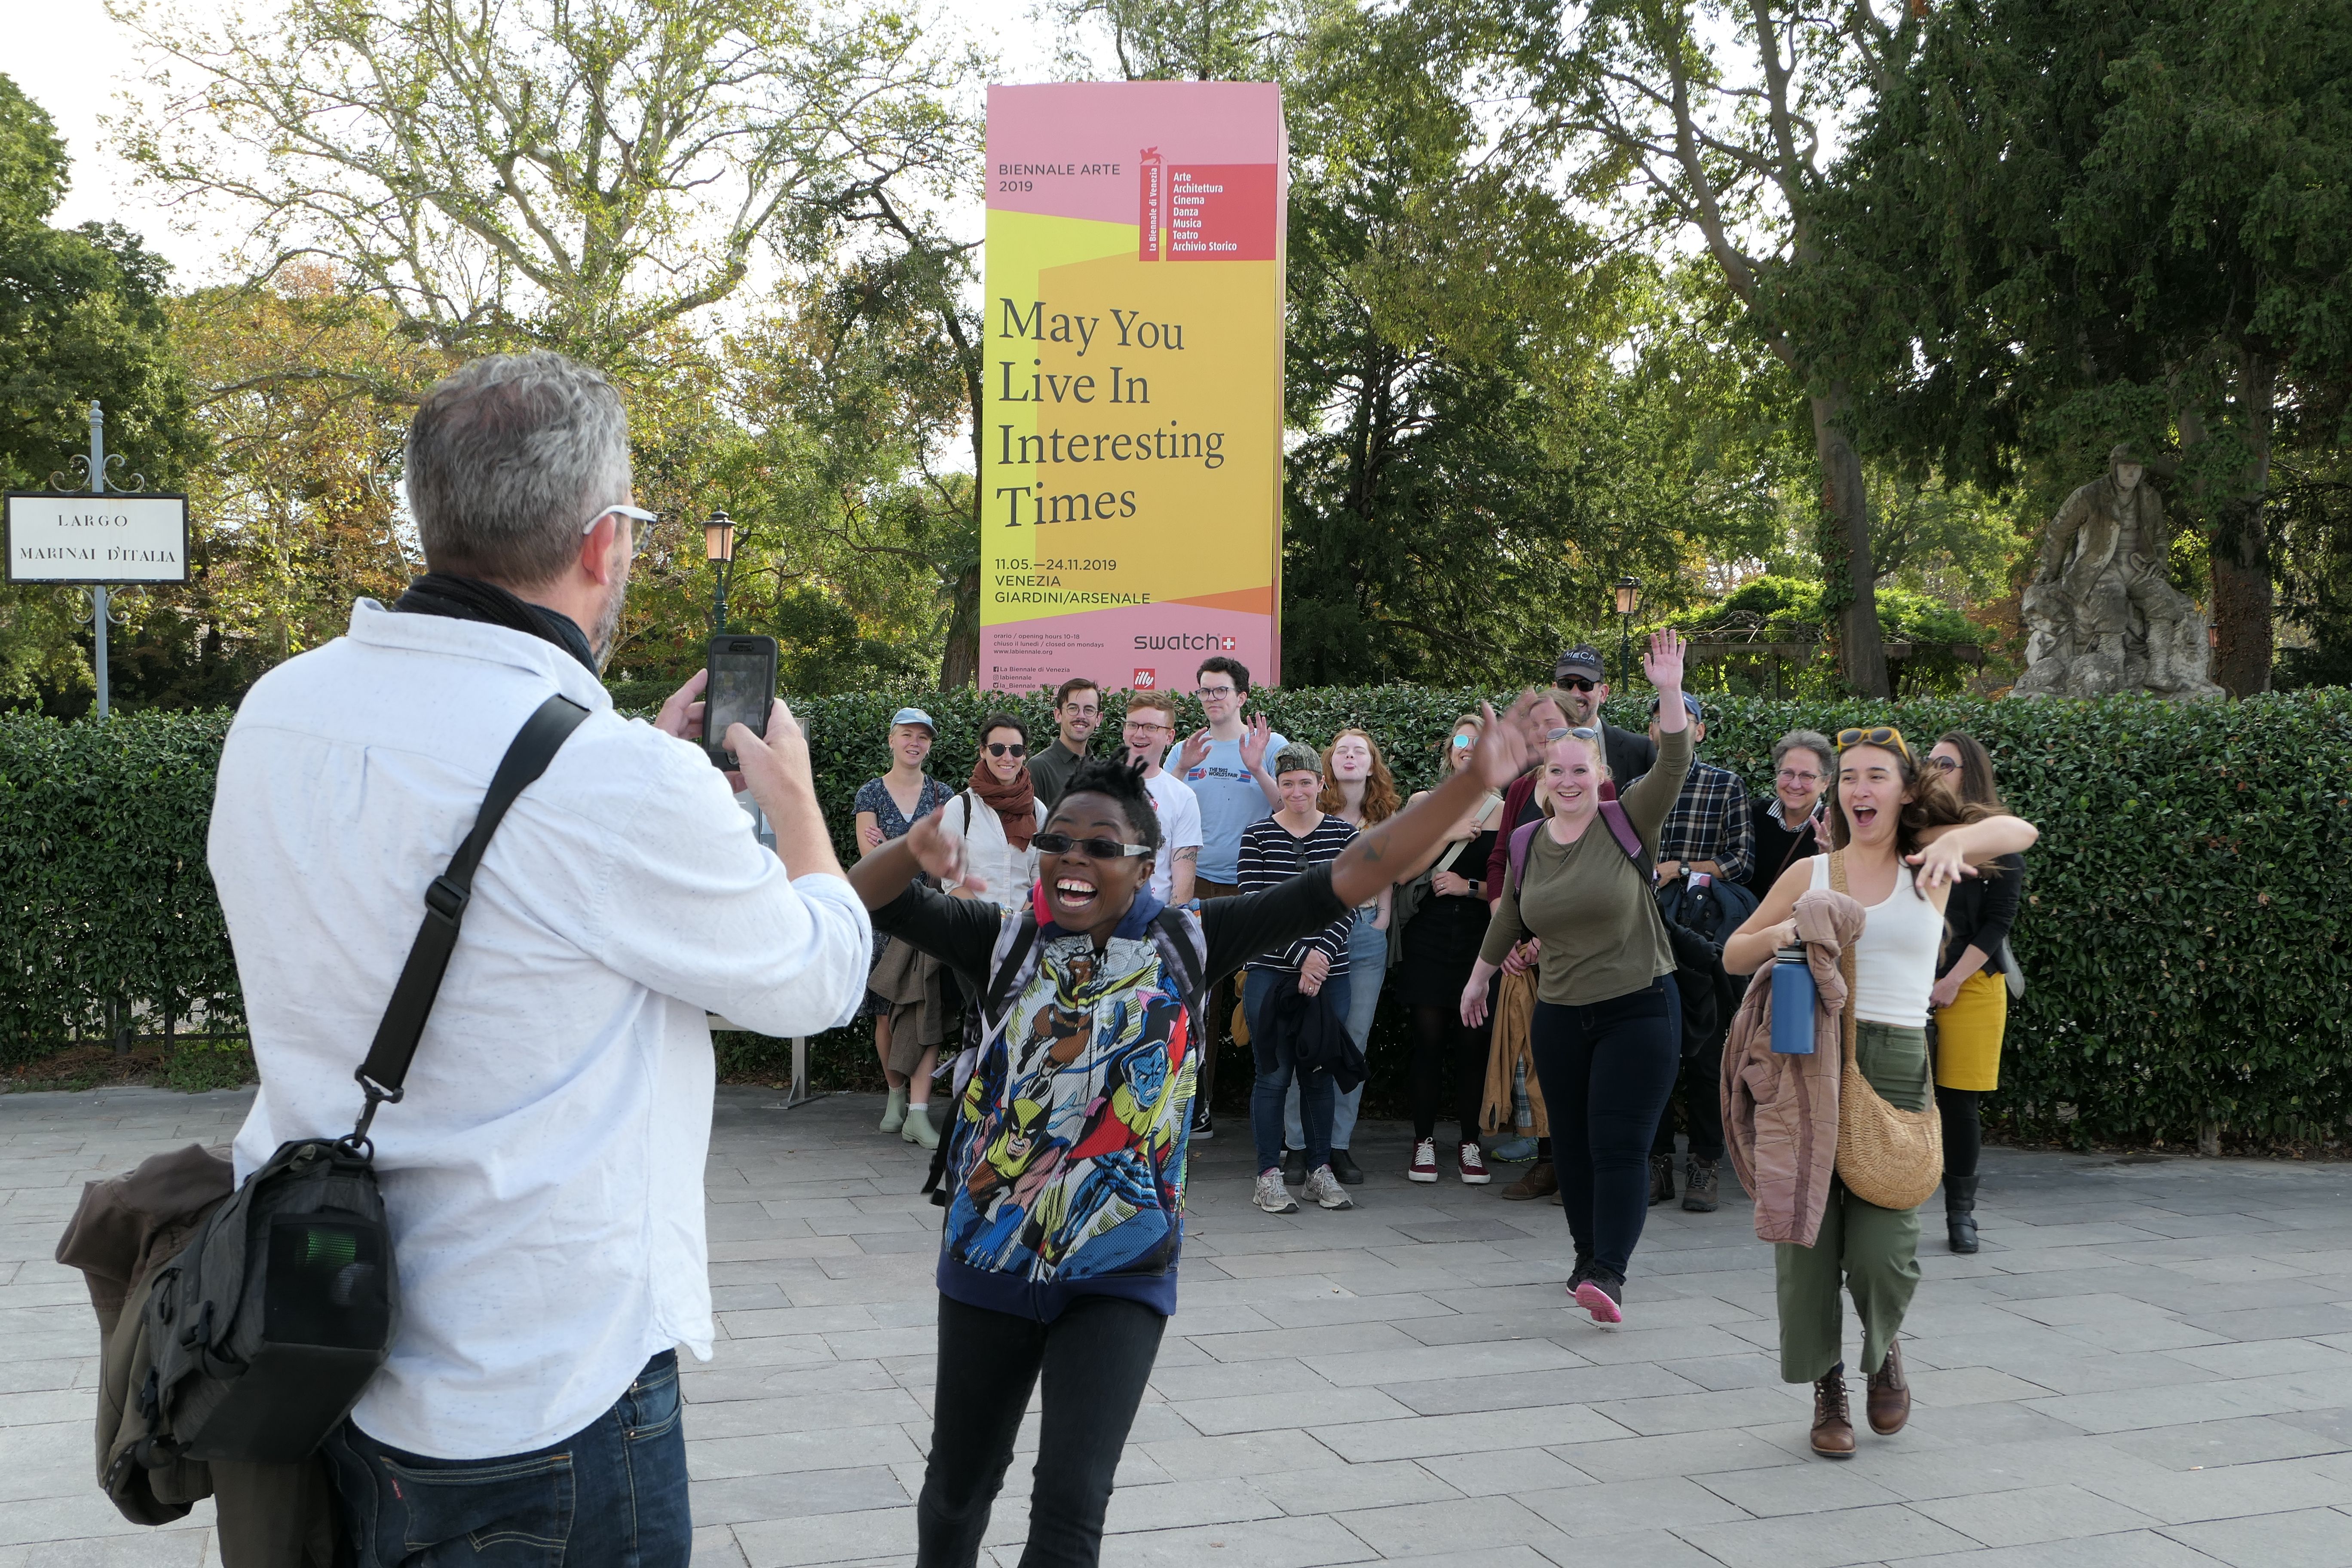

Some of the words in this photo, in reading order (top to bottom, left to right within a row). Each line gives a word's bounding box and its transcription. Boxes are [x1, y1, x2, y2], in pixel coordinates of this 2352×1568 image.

[999, 164, 1075, 175] BIENNALE
[1081, 164, 1120, 175] ARTE
[1173, 172, 1191, 181] Arte
[999, 181, 1033, 192] 2019
[1173, 183, 1223, 193] Architettura
[1173, 195, 1204, 205] Cinema
[1173, 207, 1198, 216] Danza
[1173, 217, 1201, 228] Musica
[1173, 230, 1198, 239] Teatro
[1172, 241, 1207, 251] Archivio
[1209, 241, 1237, 251] Storico
[999, 298, 1099, 357] May
[1110, 309, 1184, 350] You
[999, 359, 1094, 403] Live
[1110, 367, 1150, 403] In
[998, 420, 1224, 469] Interesting
[997, 482, 1136, 527] Times
[58, 515, 128, 527] LARGO
[20, 548, 95, 560] MARINAI
[109, 547, 175, 562] D'ITALIA
[995, 575, 1061, 587] VENEZIA
[995, 591, 1150, 605] GIARDINI/ARSENALE
[1134, 634, 1219, 650] swatch
[1135, 671, 1154, 688] illy
